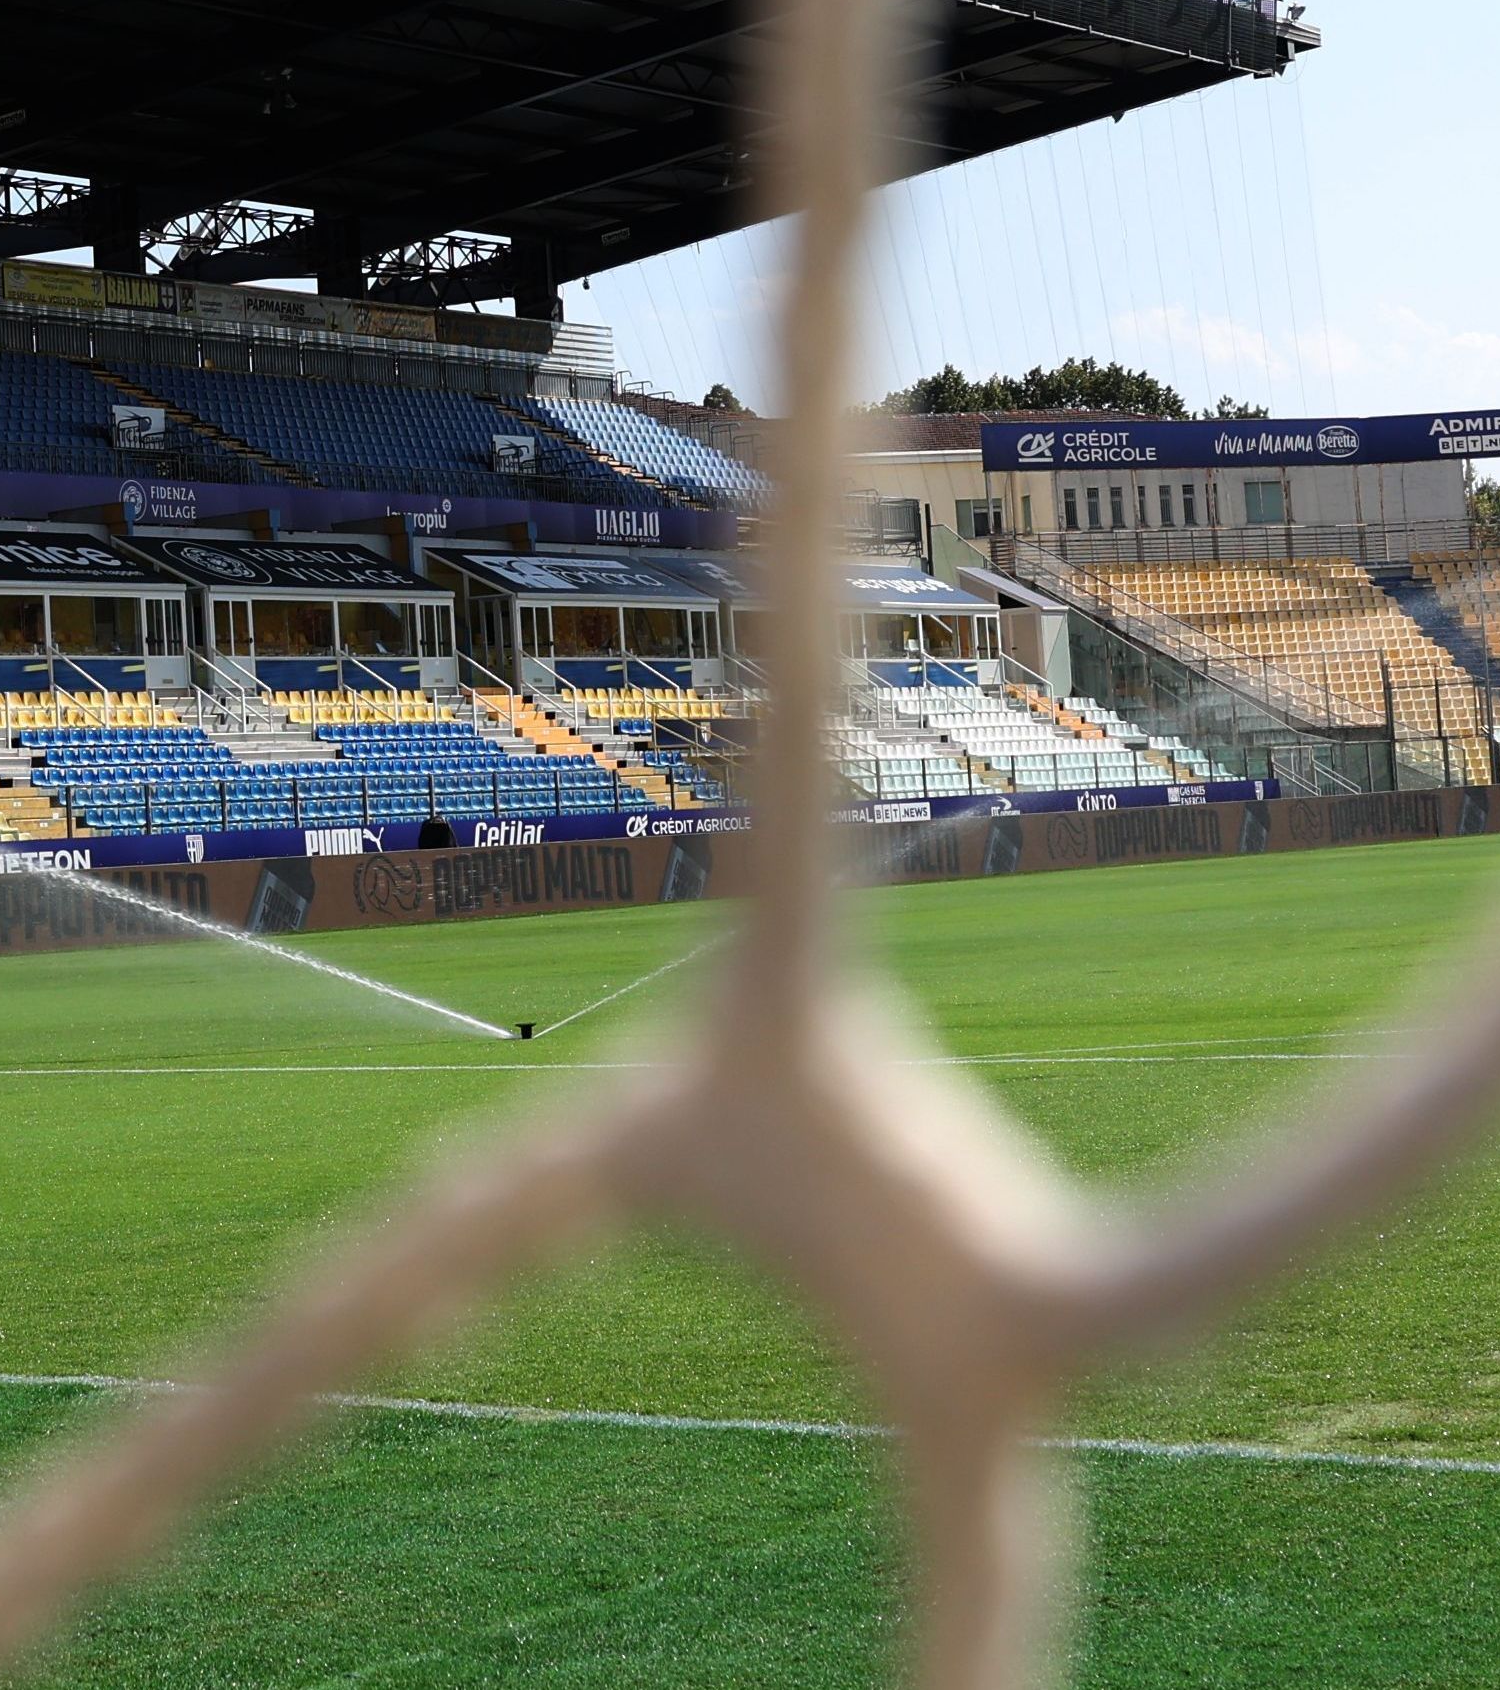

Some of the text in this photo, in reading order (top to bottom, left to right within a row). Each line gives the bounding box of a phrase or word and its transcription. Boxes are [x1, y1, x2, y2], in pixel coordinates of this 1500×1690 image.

[247, 298, 305, 316] PARMAFANS
[1062, 429, 1130, 447] CRÉDIT
[1259, 432, 1314, 455] MAMMA
[1319, 432, 1359, 450] Beretta
[1063, 447, 1158, 463] AGRICOLE
[150, 485, 196, 502] FIDENZA
[151, 503, 197, 520] VILLAGE
[238, 547, 378, 565] FIDENZA
[274, 566, 414, 584] VILLAGE
[474, 821, 545, 848] Cetilar
[651, 817, 693, 836] CRÉDIT
[696, 816, 752, 832] AGRICOLE
[1094, 805, 1221, 865] DOPPIO MALTO
[304, 828, 364, 857] PUMA
[433, 848, 540, 917] DOPPIO
[543, 846, 634, 901] MALTO
